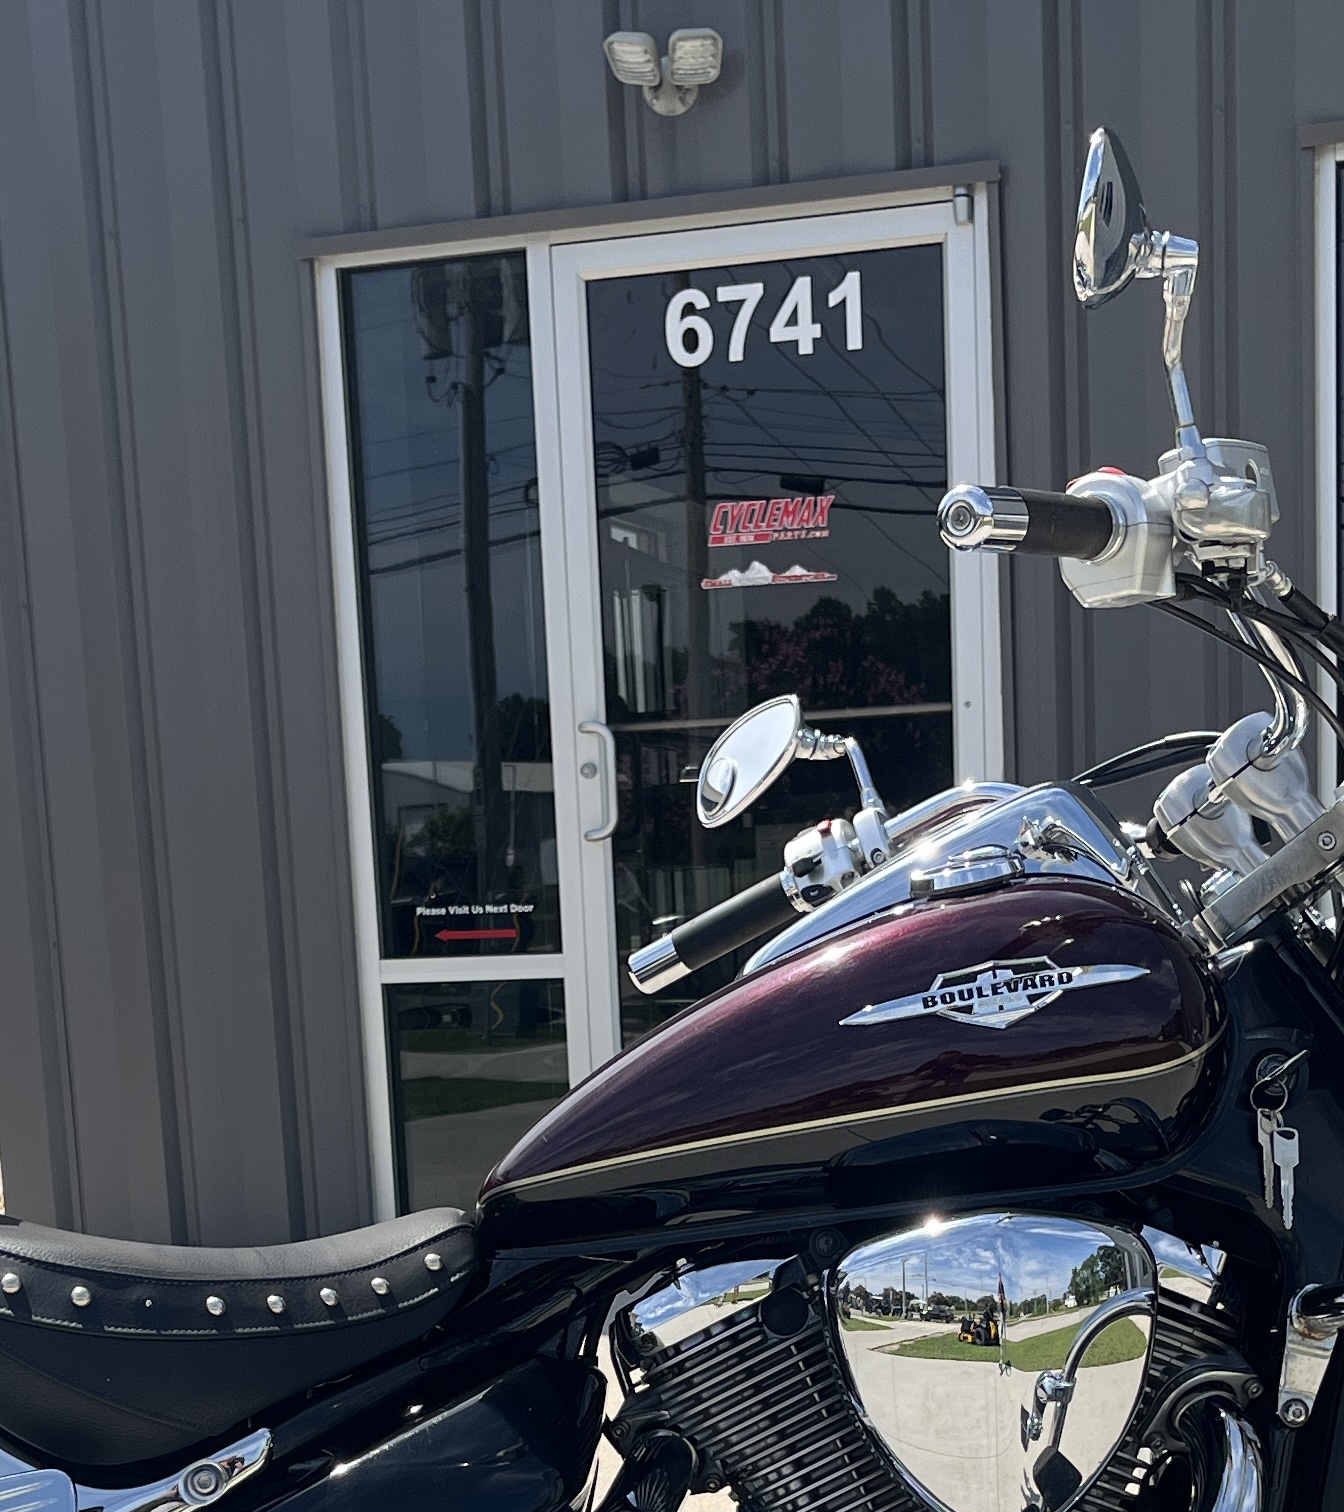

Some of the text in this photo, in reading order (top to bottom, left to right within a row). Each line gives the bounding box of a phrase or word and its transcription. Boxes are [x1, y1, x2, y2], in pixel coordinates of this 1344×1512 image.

[665, 270, 863, 368] 6741
[710, 495, 835, 534] CYCLEMAX
[416, 903, 534, 916] Please Visit Us Next Door
[921, 970, 1074, 1010] BOULEVARD
